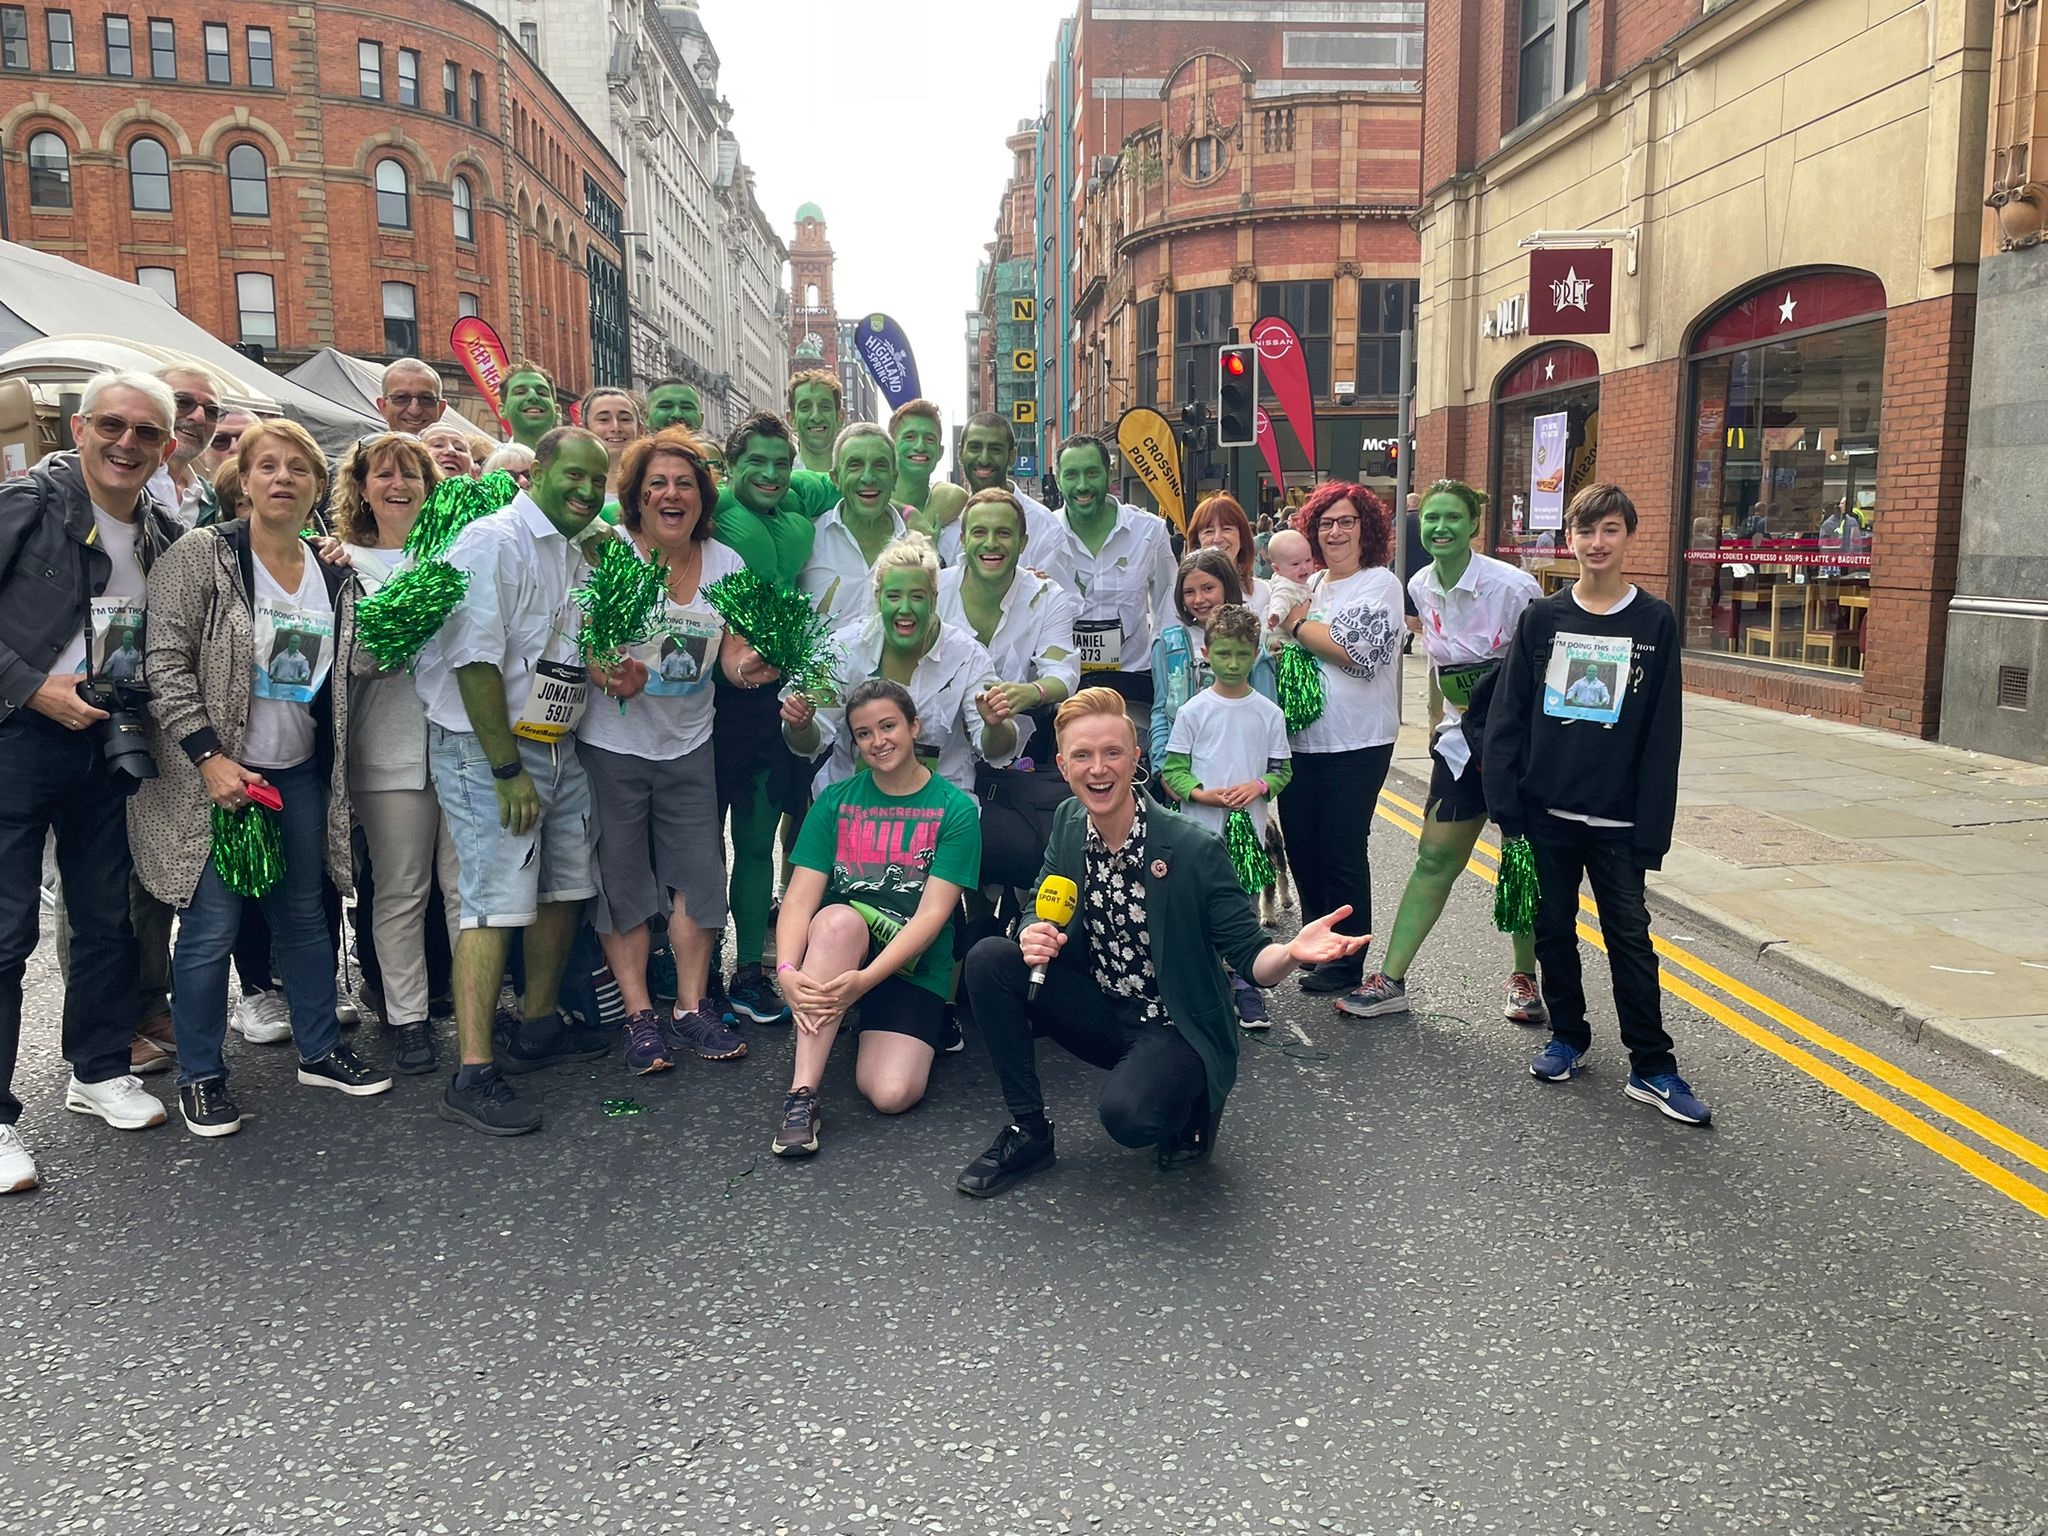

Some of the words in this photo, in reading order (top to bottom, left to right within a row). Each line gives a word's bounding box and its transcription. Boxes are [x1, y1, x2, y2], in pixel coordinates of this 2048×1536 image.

[1553, 279, 1591, 306] PRET
[1255, 338, 1294, 347] NISSAN
[865, 335, 902, 393] HIGHLAND
[867, 352, 888, 384] SPRING
[1128, 446, 1159, 484] POINT
[1143, 436, 1181, 498] CROSSING
[1688, 551, 1717, 560] CAPPUCCINO
[1722, 552, 1743, 560] COOKIES
[1750, 553, 1777, 562] ESPRESSO
[1784, 554, 1803, 562] SOUPS
[1811, 555, 1829, 563] LATTE
[1555, 640, 1567, 648] I'M
[1567, 641, 1592, 650] DOING
[1594, 644, 1609, 652] THIS
[1636, 643, 1656, 652] HOW
[537, 682, 587, 704] JONATHAN
[545, 703, 574, 723] 5918
[1039, 893, 1061, 904] SPORT
